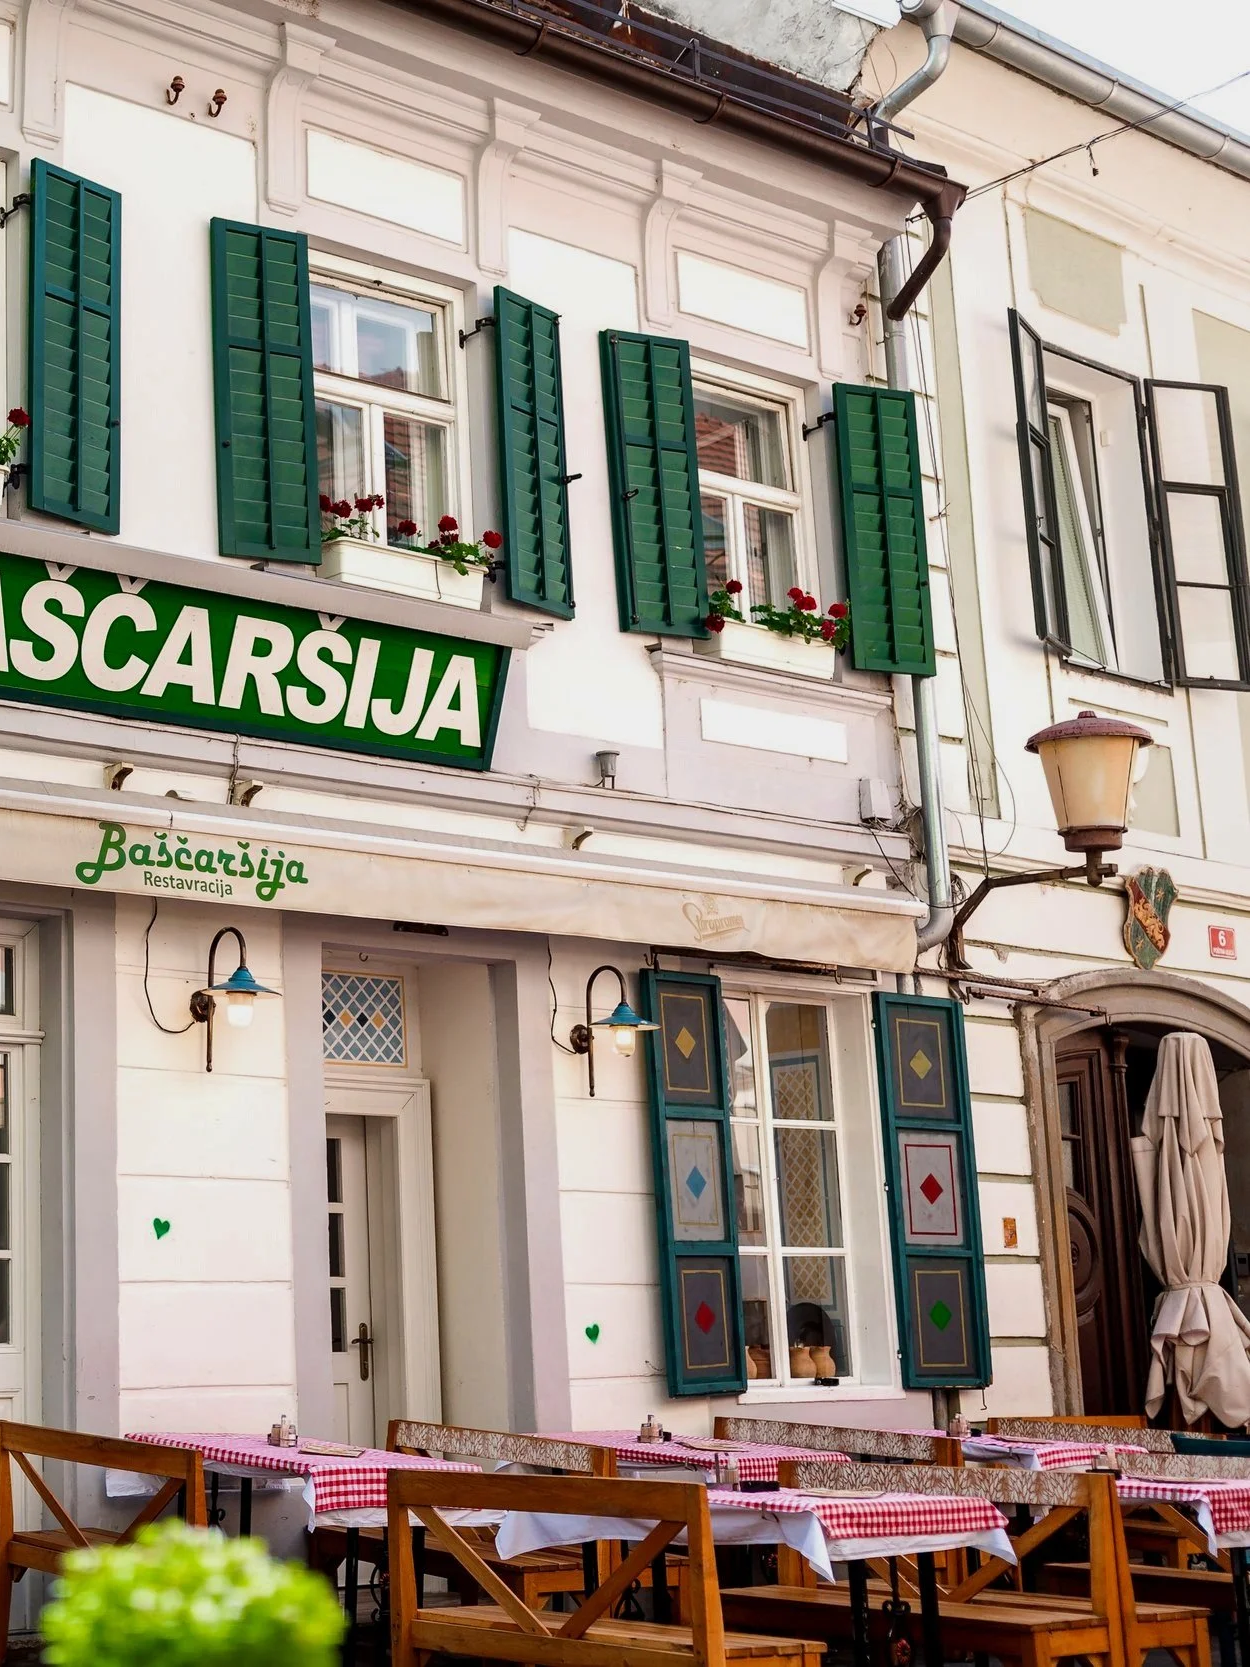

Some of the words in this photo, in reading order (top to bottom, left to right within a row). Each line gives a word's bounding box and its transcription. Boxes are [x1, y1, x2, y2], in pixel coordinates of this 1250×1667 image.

[75, 820, 309, 902] Baščaršija
[144, 870, 233, 898] Restavracija
[1218, 930, 1226, 946] 6
